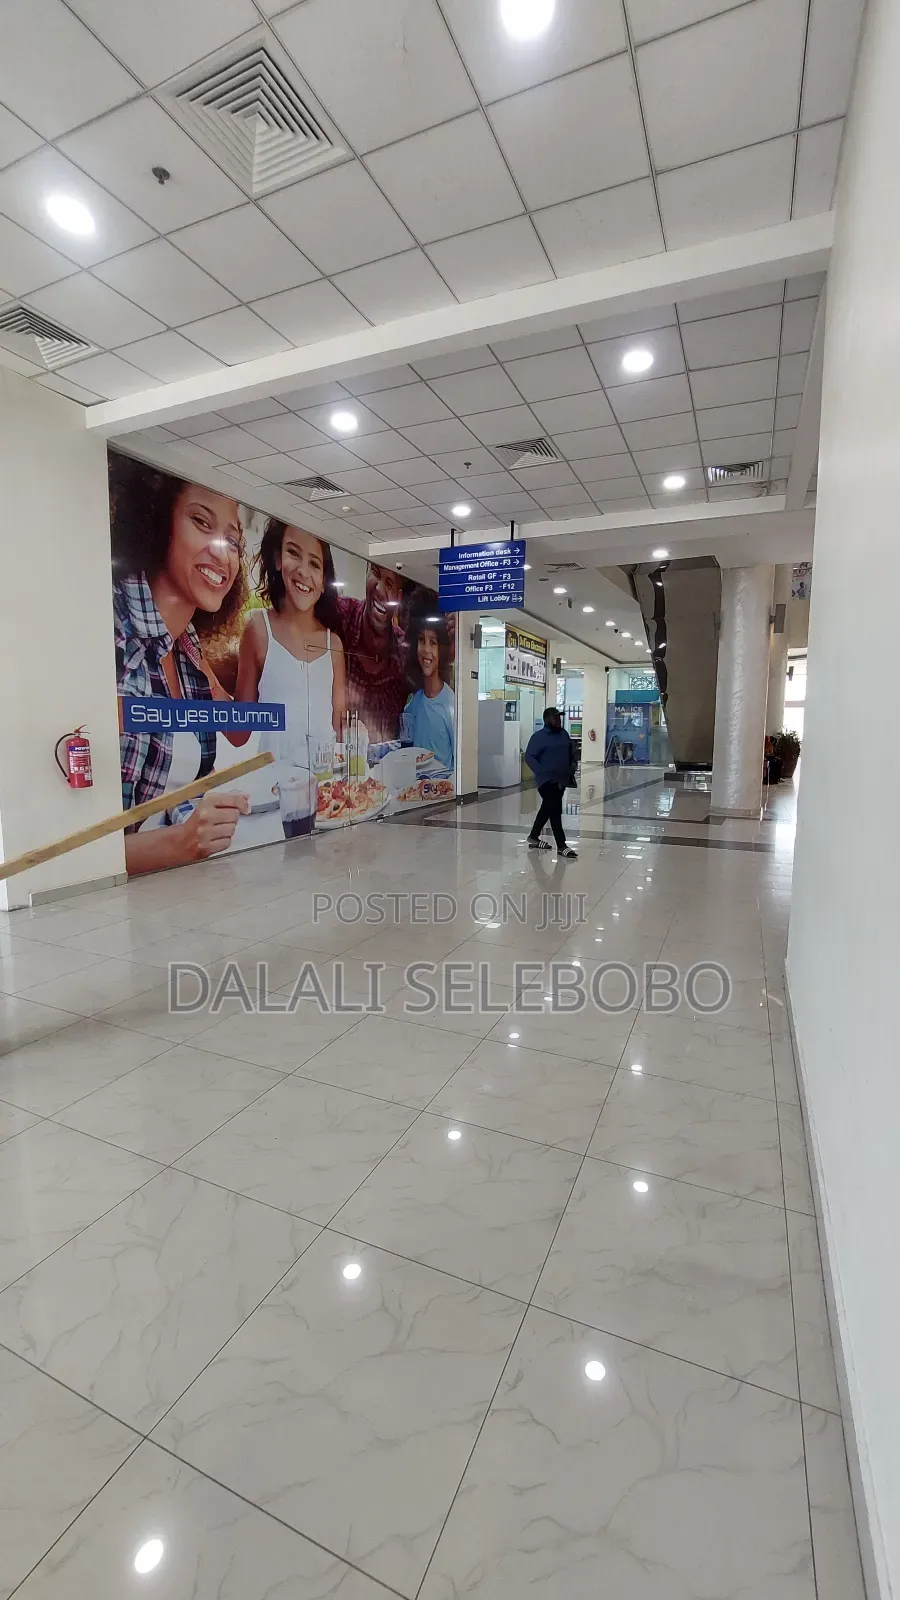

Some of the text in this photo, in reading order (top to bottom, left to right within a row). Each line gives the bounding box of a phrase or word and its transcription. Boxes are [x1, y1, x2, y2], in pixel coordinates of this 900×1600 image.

[458, 551, 495, 559] Information
[444, 562, 479, 571] Management
[490, 594, 510, 602] Lobby
[130, 704, 279, 728] Say yes to tummy
